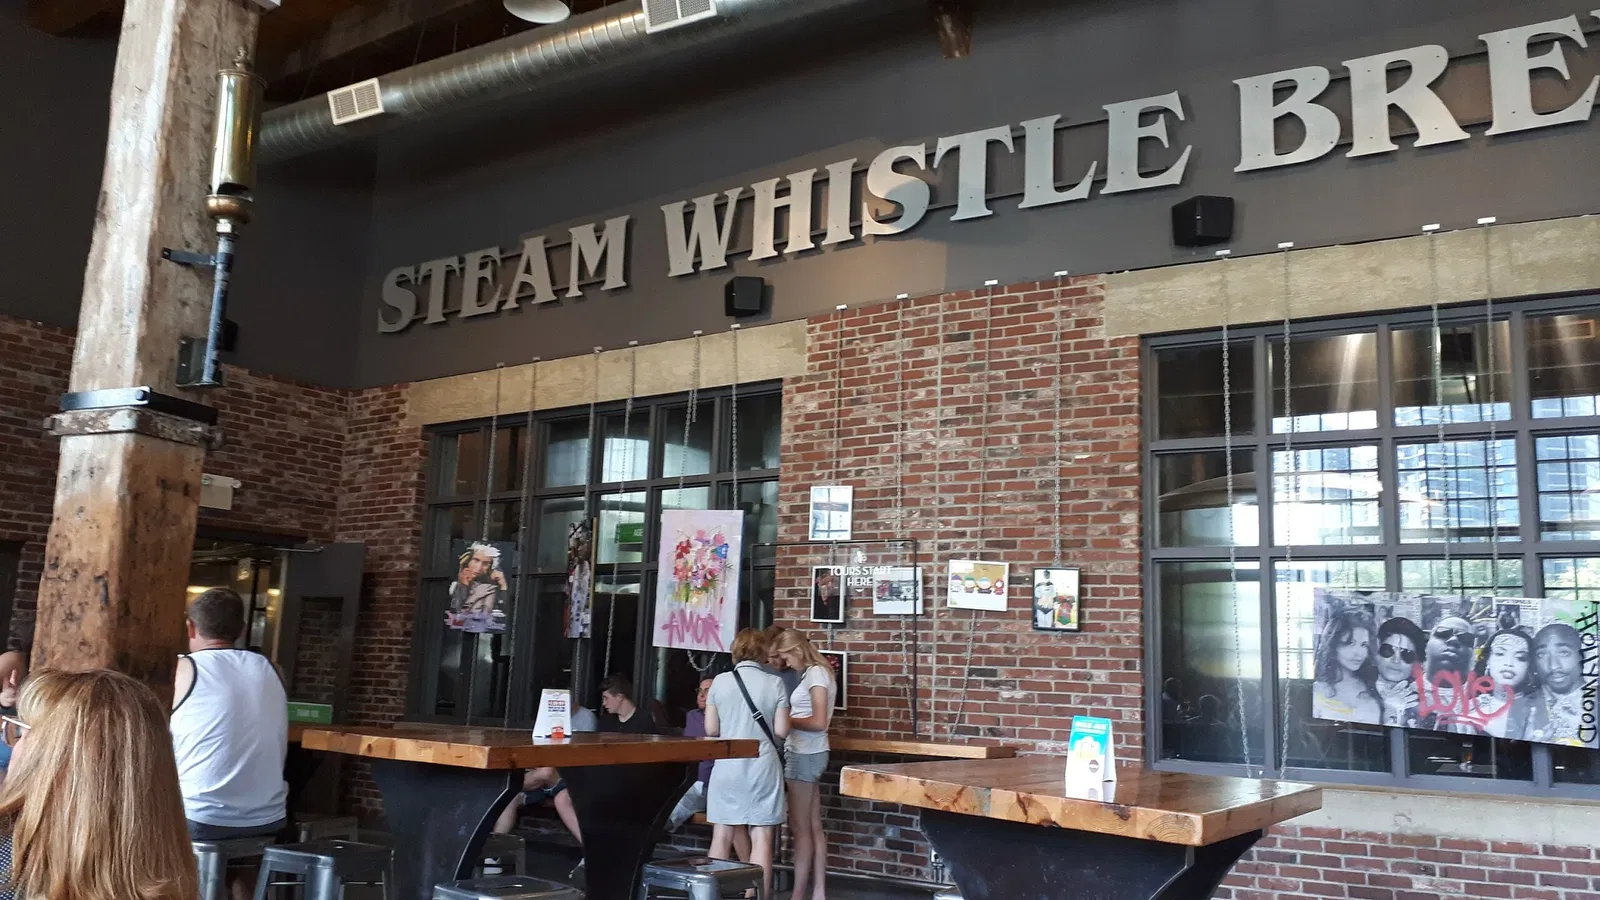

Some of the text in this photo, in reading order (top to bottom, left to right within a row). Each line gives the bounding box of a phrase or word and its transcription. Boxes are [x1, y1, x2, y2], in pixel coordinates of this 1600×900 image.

[377, 9, 1600, 332] STEAM WHISTLE BRE
[829, 565, 893, 577] TOURS START
[847, 577, 873, 587] HERE
[662, 608, 724, 651] AMOR
